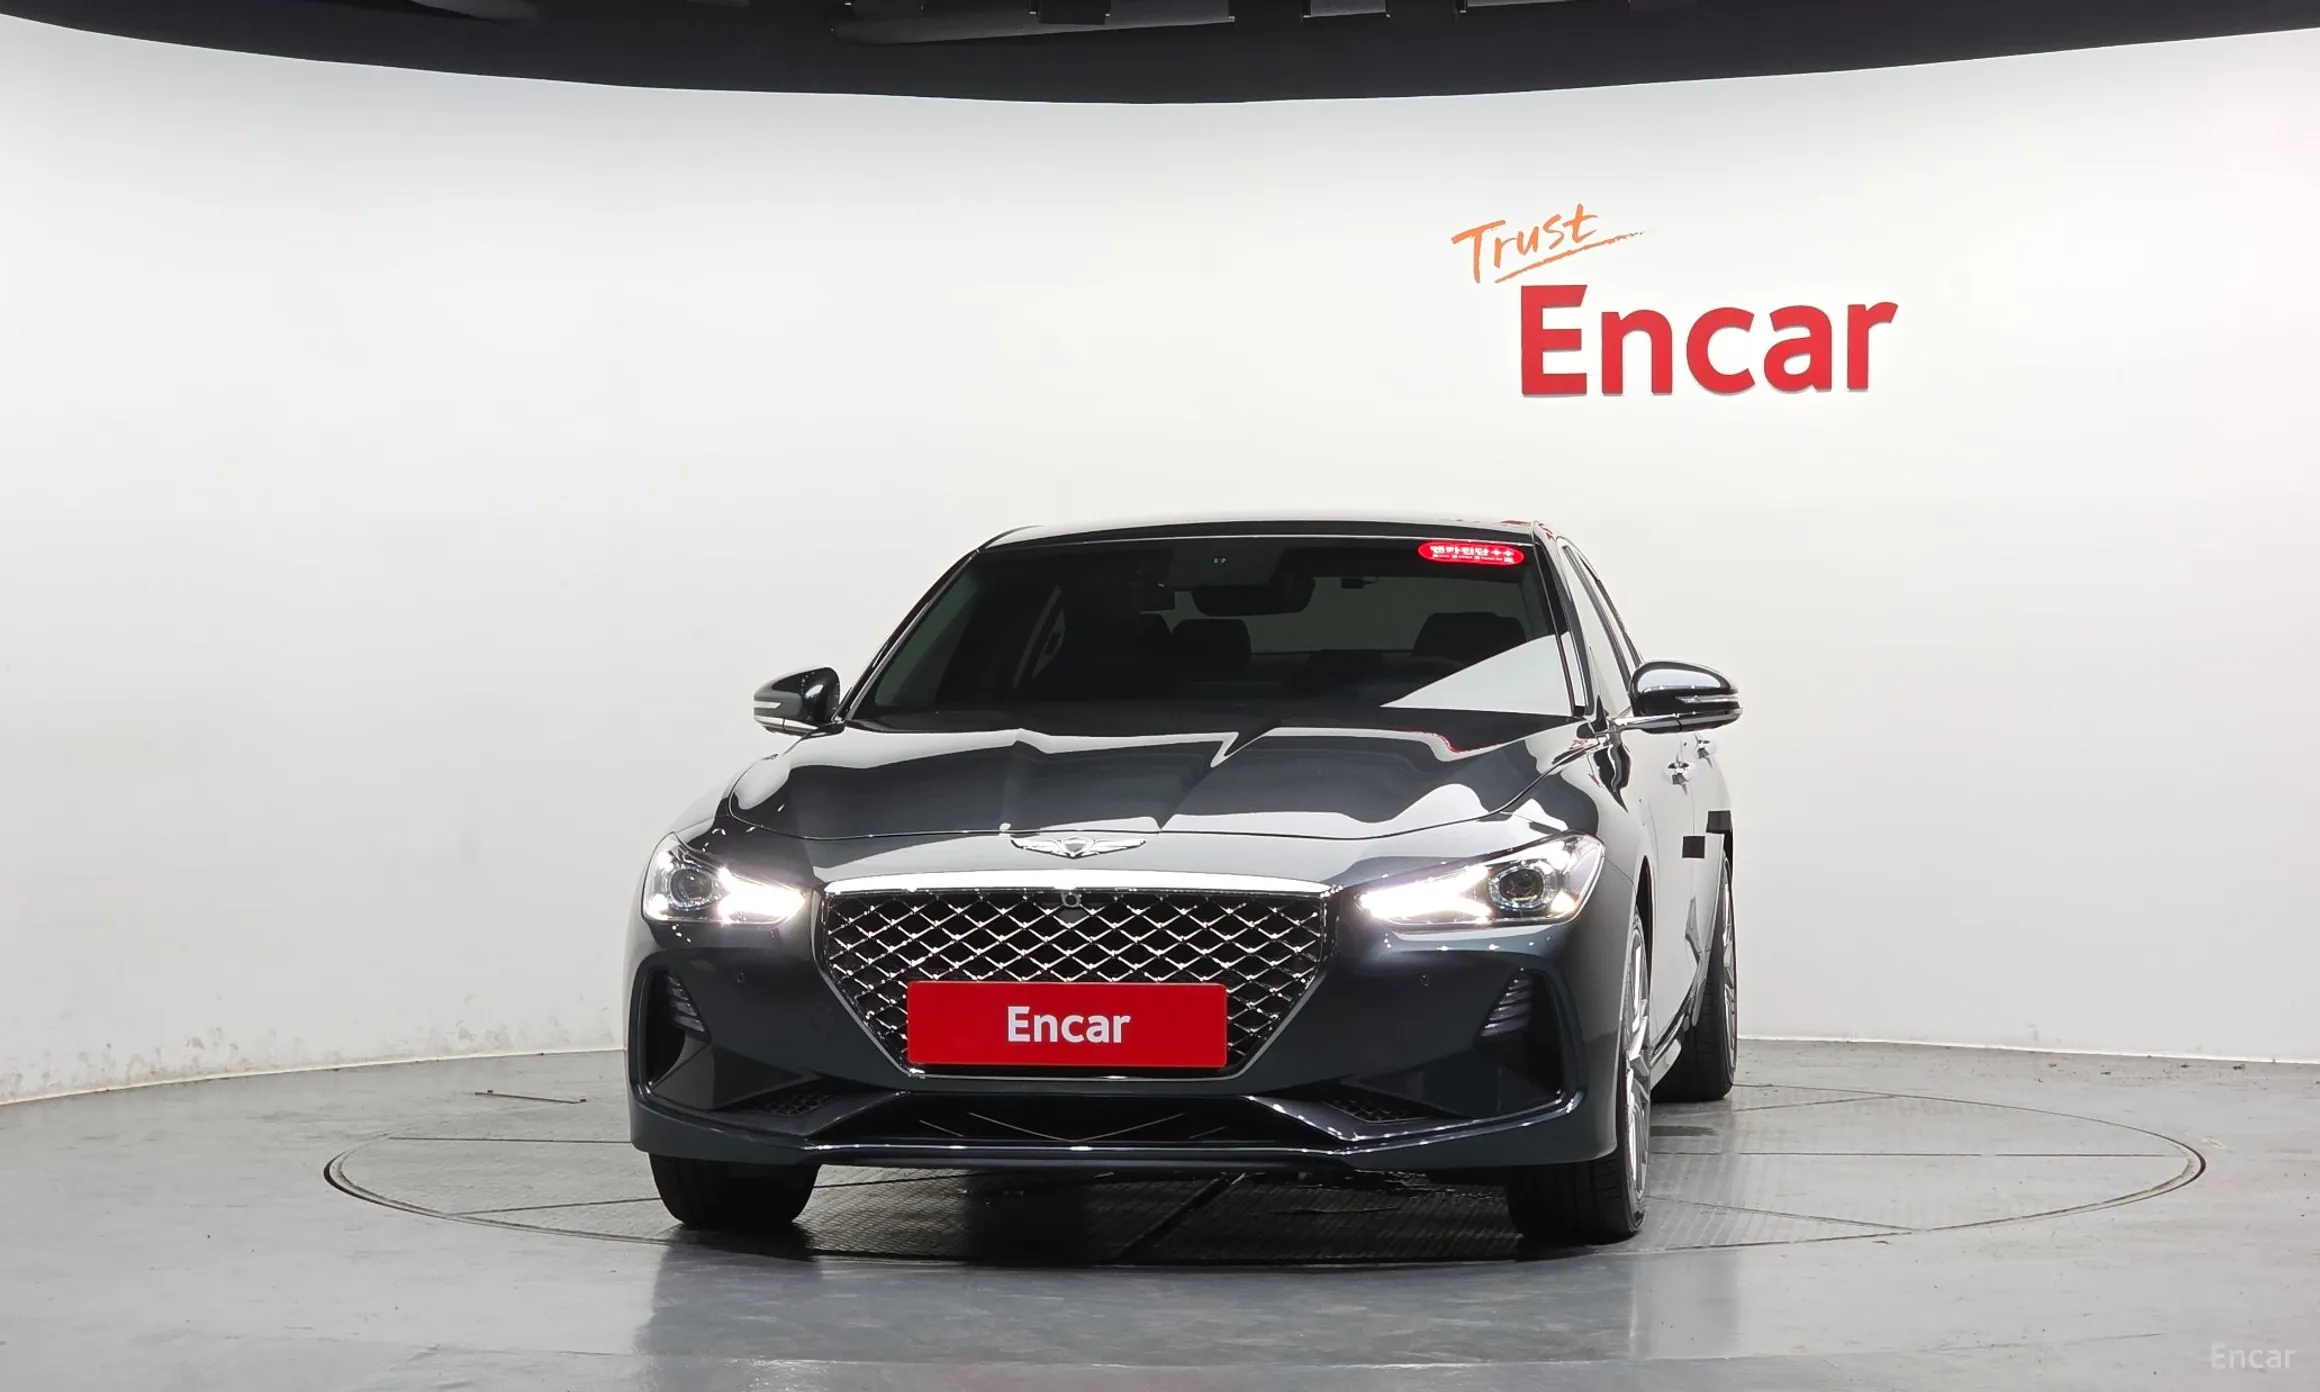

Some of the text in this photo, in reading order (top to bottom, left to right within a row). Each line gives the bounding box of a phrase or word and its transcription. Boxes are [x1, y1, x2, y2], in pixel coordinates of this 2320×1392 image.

[1451, 203, 1600, 283] Trust
[1520, 284, 1899, 396] Encar
[1007, 1006, 1131, 1043] Encar
